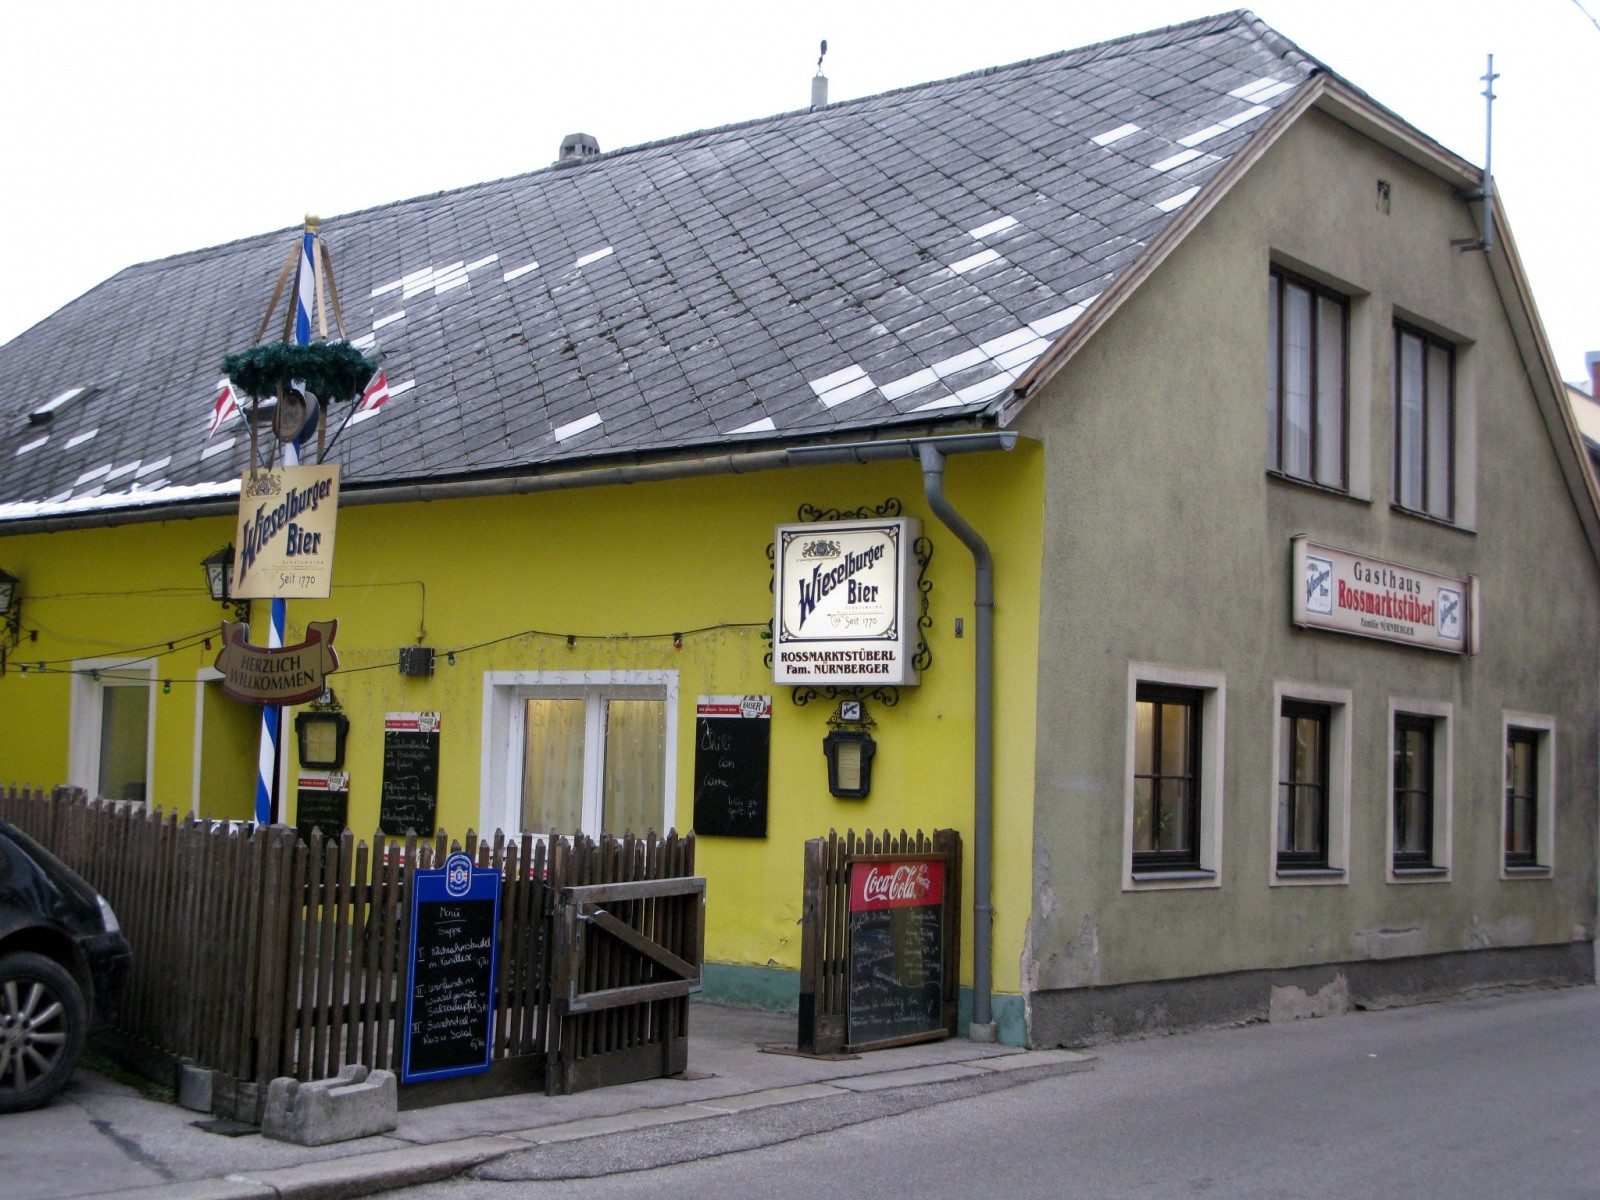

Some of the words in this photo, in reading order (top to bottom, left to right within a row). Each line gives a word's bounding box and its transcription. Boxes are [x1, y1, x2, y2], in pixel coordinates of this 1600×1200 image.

[238, 477, 332, 589] Wieselburger
[285, 522, 321, 557] Bier
[279, 572, 295, 589] Seit
[298, 575, 316, 589] 1770
[798, 543, 885, 631] Wieselburger
[1353, 561, 1421, 595] Gasthaus
[847, 578, 879, 605] Bier
[1338, 579, 1435, 626] Rossmarktstüberl
[844, 616, 859, 630] Seit
[863, 617, 877, 628] 1770
[240, 655, 301, 674] HERZLICH
[780, 648, 897, 663] ROSSMARKTSTÜBERL
[786, 664, 811, 675] Fam.
[814, 661, 890, 674] NÜRNBERGER
[228, 668, 315, 691] WILLKOMMEN
[742, 700, 762, 711] KAISER
[863, 865, 917, 902] Coca-Cola
